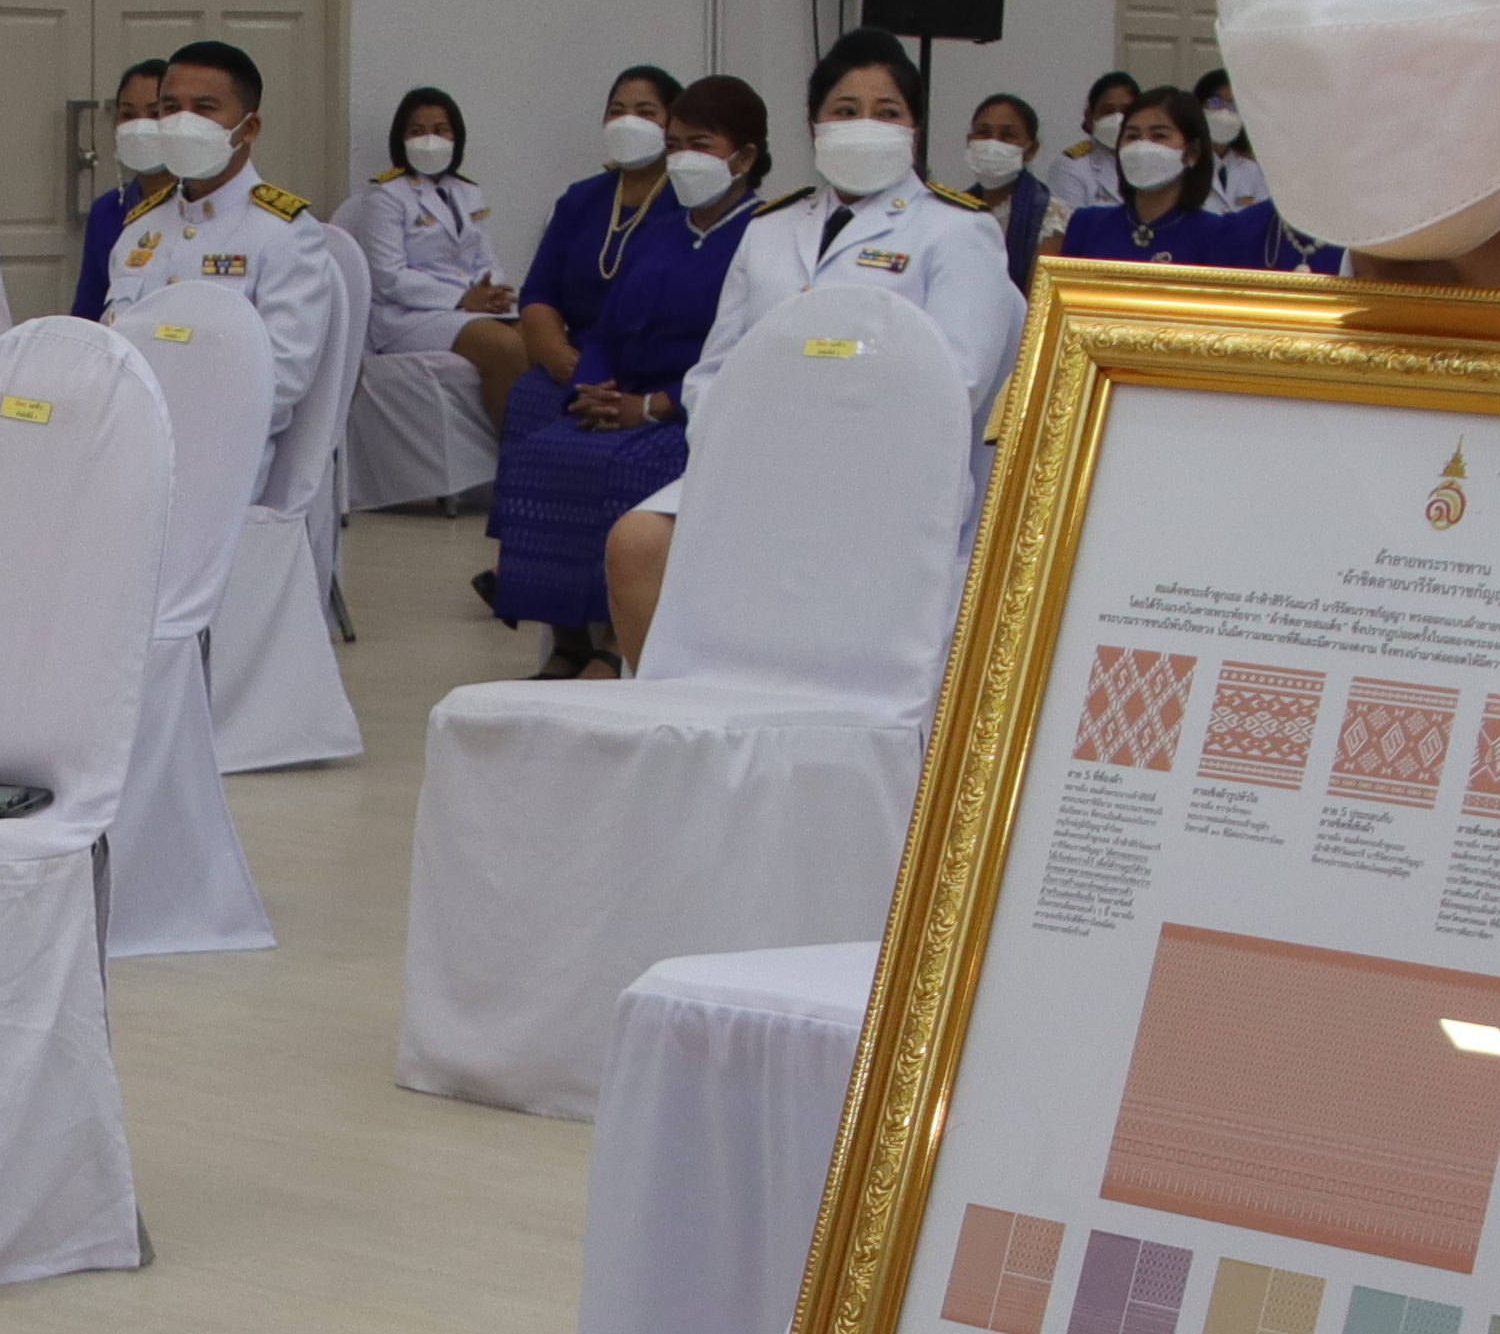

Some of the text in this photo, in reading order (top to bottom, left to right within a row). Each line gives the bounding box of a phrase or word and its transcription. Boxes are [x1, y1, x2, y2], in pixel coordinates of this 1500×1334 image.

[1373, 546, 1493, 577] ผ้าลายพระราชทาน
[1083, 769, 1091, 781] S
[1339, 805, 1348, 817] S
